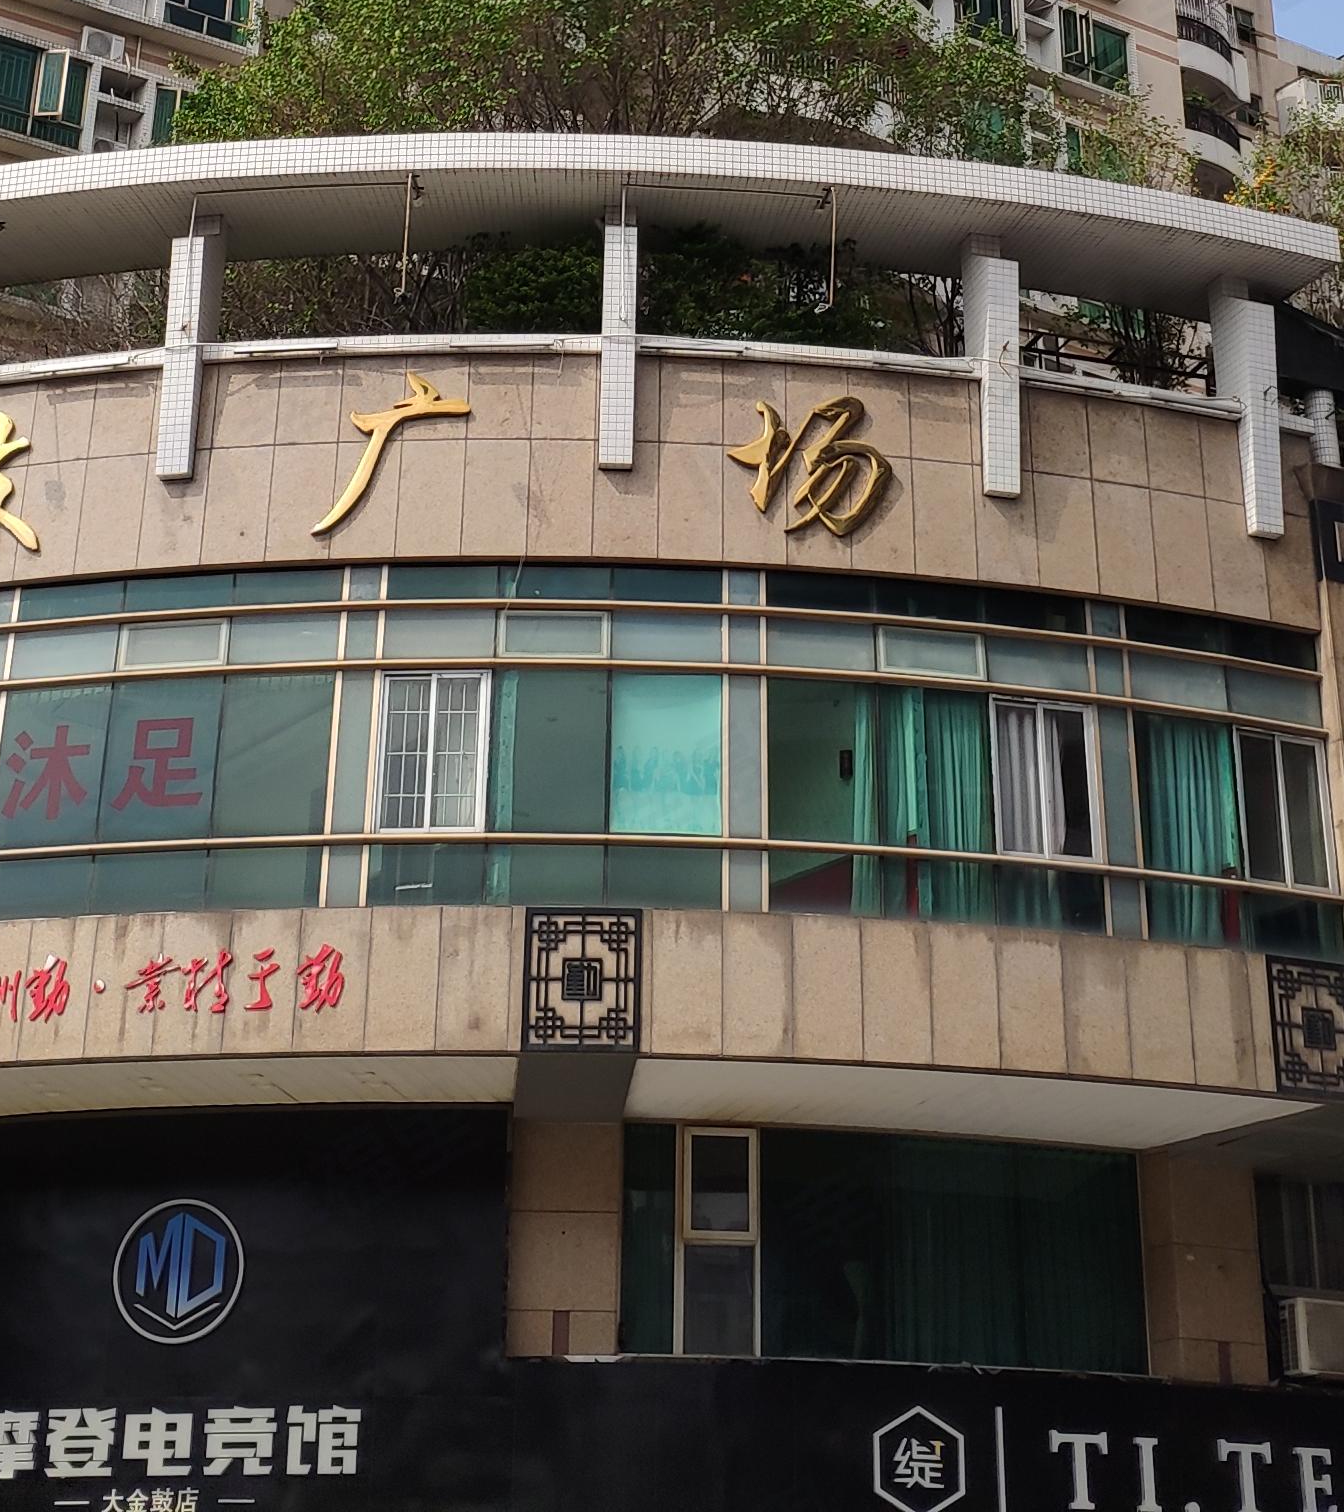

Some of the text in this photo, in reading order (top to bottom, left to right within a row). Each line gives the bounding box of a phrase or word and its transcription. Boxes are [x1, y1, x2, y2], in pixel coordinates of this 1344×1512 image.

[0, 716, 205, 821] 沐足
[135, 1212, 226, 1319] MD
[101, 1486, 200, 1512] 大金鼓店
